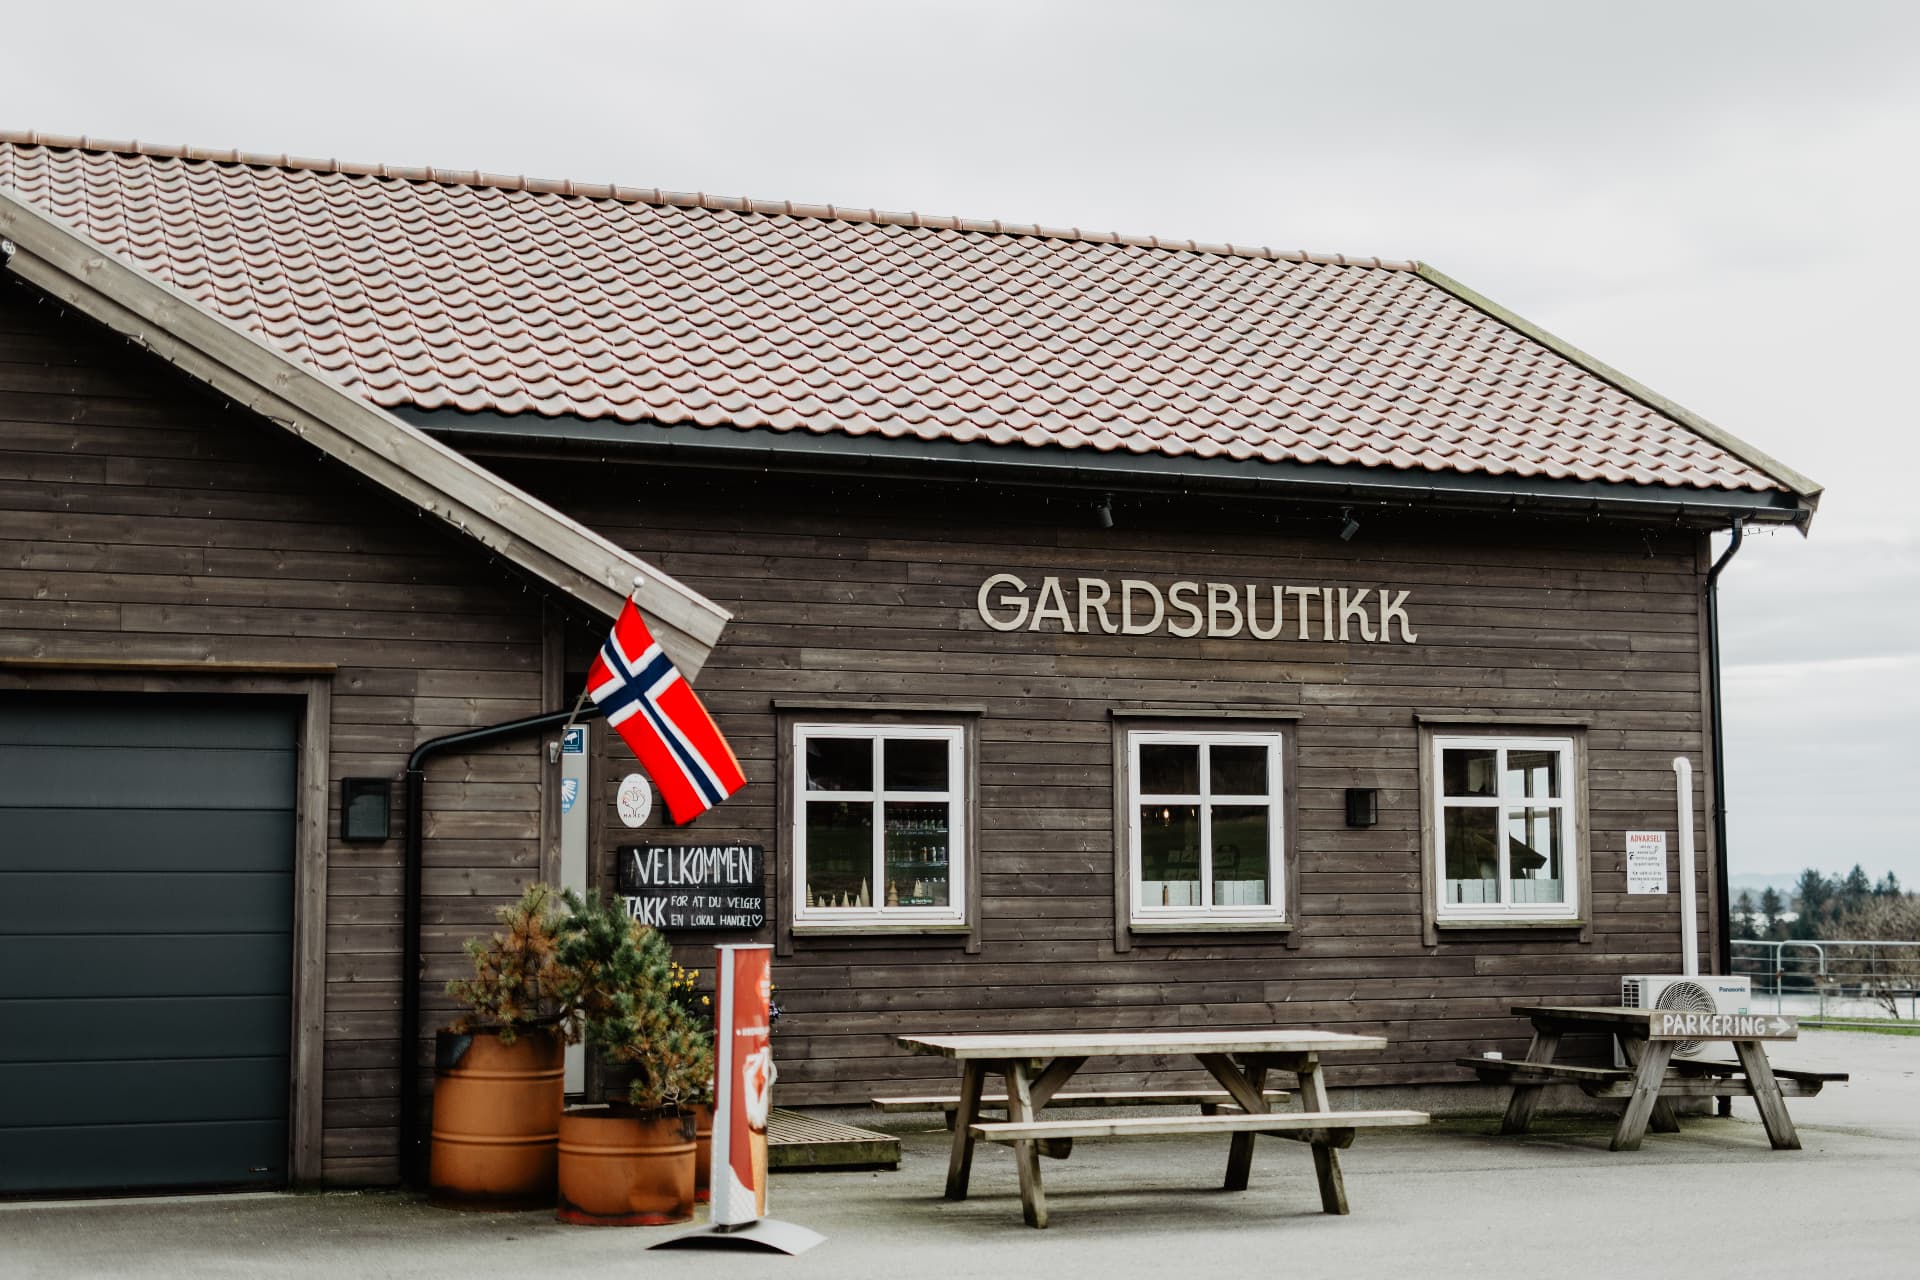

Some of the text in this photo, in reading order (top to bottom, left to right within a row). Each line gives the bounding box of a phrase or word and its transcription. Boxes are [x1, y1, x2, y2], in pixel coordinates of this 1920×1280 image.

[977, 573, 1418, 644] GARDSBUTIKK
[633, 847, 753, 885] VELKOMMEN
[624, 896, 668, 927] TAKK
[671, 896, 761, 909] FOR AT DU VELGER
[671, 914, 752, 927] EN LOKAL HANDEL
[1662, 1014, 1766, 1036] PARKERING
